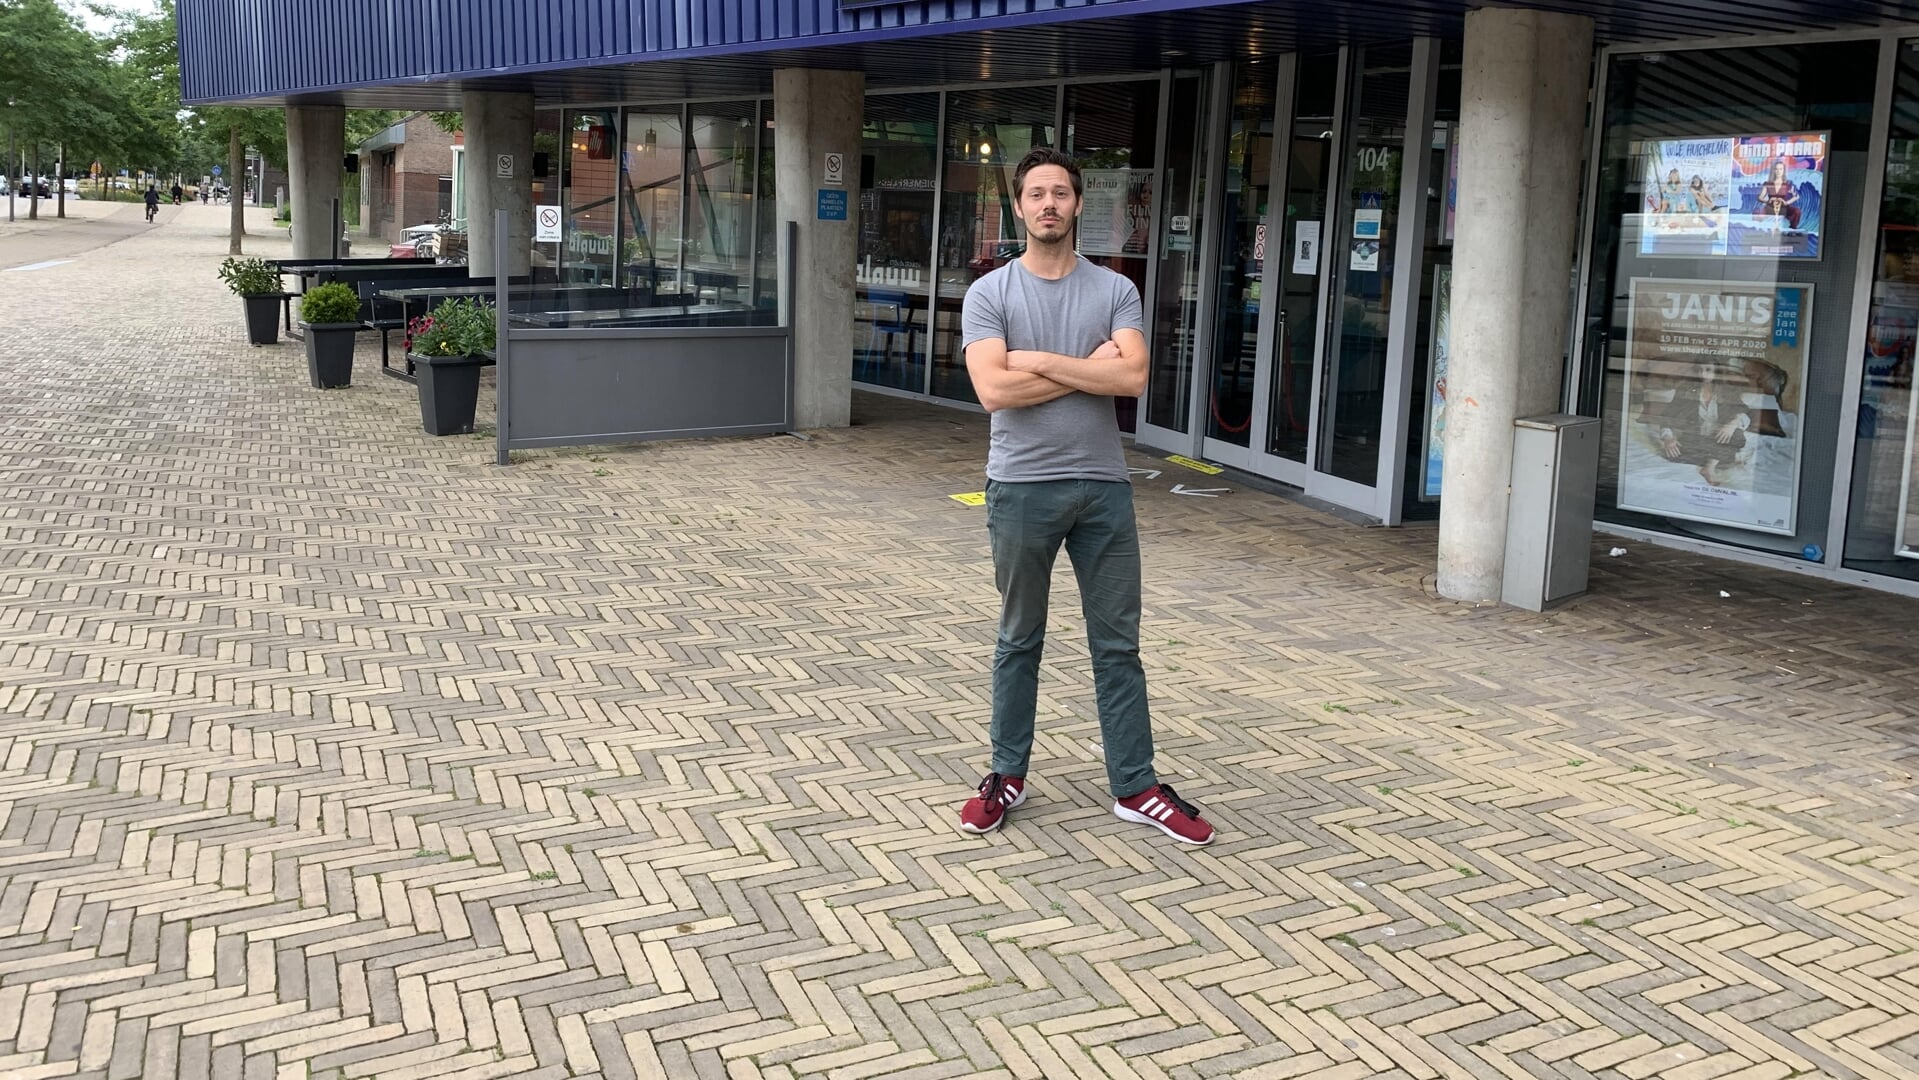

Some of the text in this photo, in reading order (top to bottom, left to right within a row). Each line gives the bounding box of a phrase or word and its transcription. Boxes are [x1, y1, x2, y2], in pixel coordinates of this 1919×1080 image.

[1357, 147, 1390, 172] 104
[1087, 177, 1118, 190] blauw
[1661, 292, 1771, 324] JANIS
[1777, 310, 1797, 318] zee
[1776, 318, 1796, 328] lan
[1775, 328, 1795, 337] dia
[1660, 335, 1670, 343] 19
[1673, 336, 1690, 344] FEB
[1706, 338, 1718, 346] 25
[1721, 339, 1740, 347] APR
[1742, 340, 1767, 349] 2020
